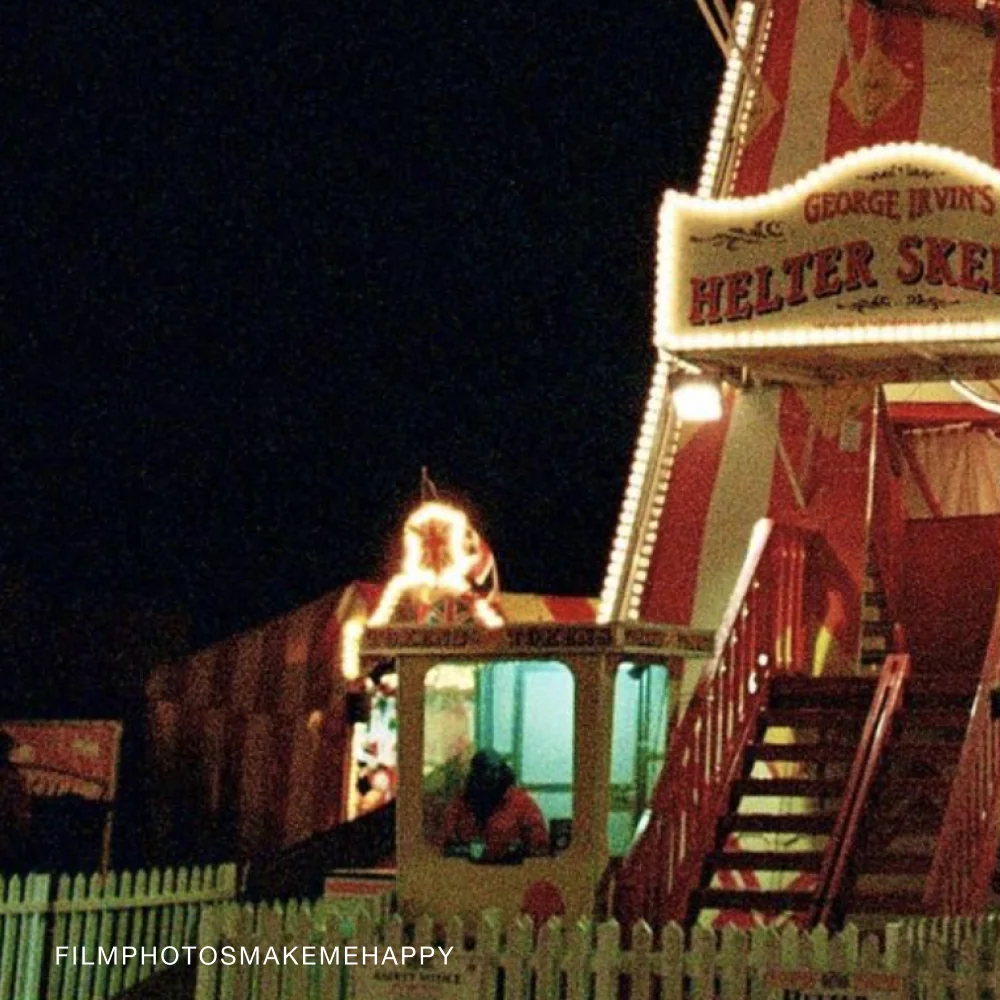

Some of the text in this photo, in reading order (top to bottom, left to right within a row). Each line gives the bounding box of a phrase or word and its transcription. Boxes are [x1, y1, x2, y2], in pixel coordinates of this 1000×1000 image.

[804, 184, 996, 224] GEORGE IRVIN'S
[688, 239, 879, 326] HELTER
